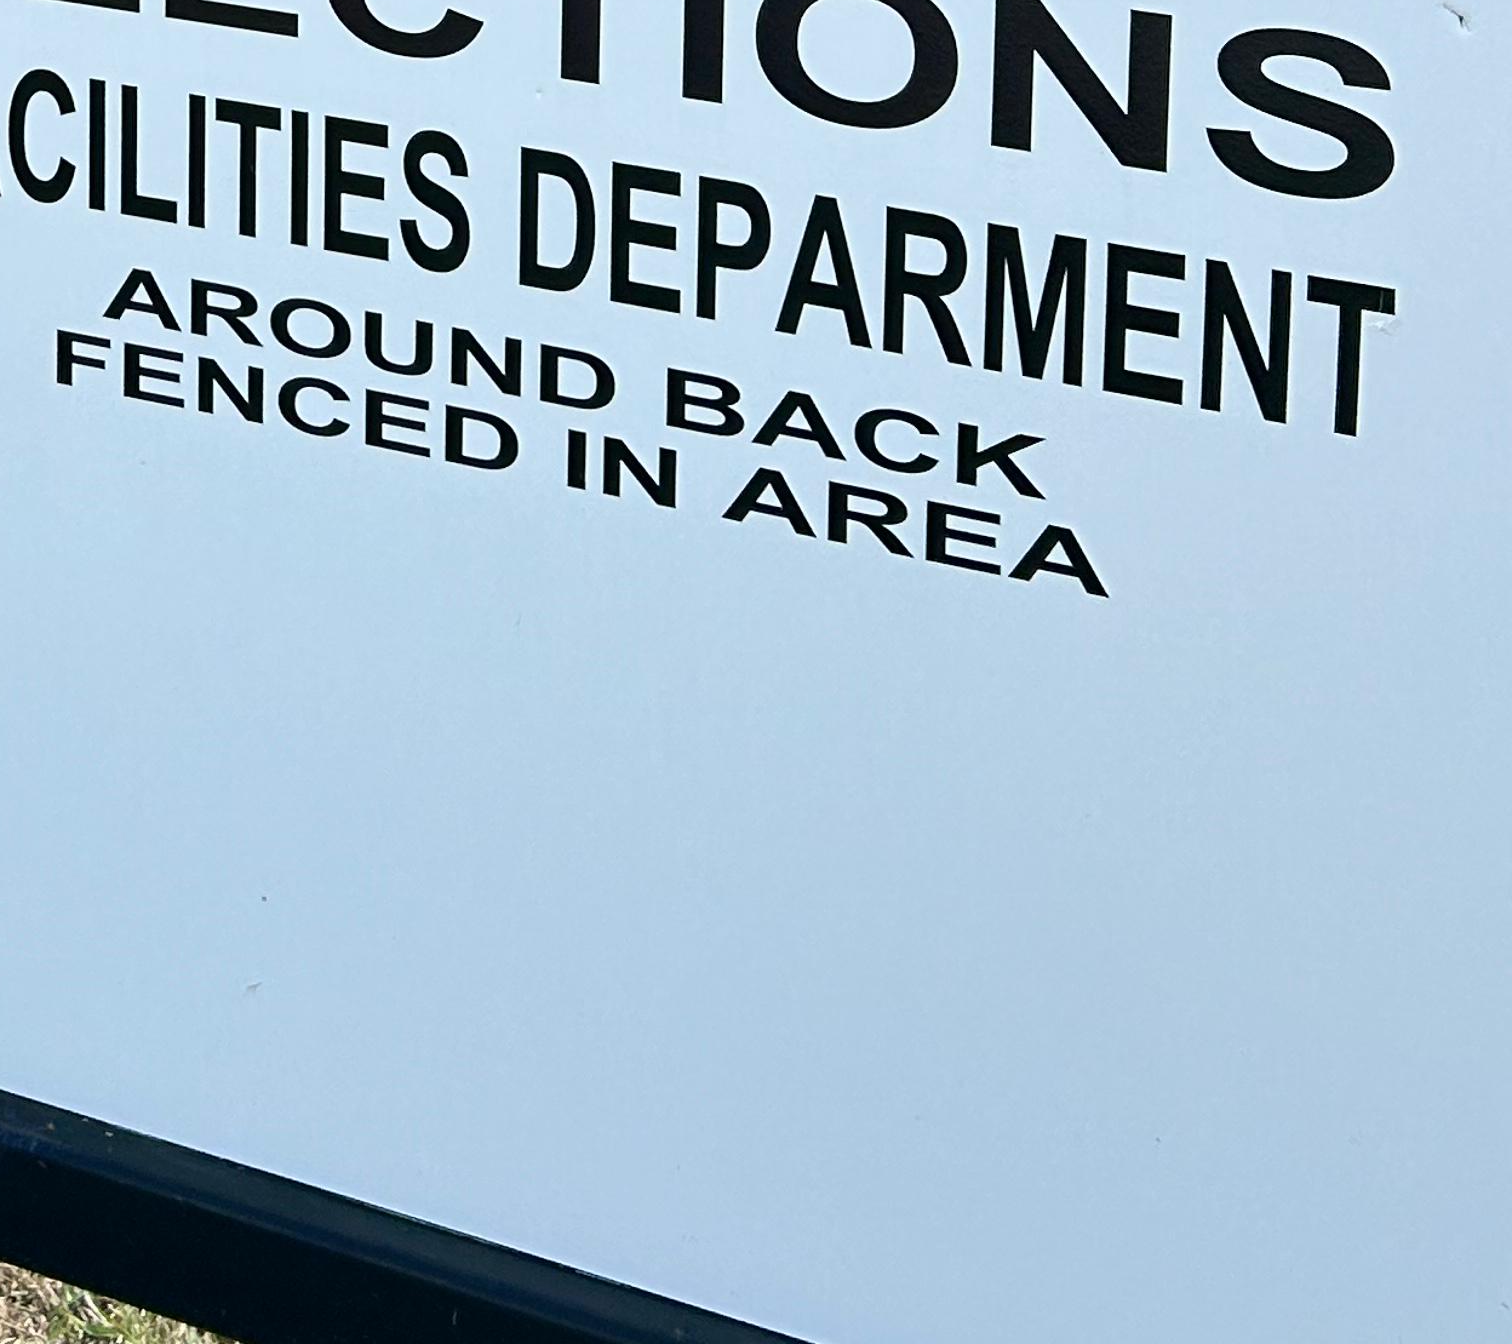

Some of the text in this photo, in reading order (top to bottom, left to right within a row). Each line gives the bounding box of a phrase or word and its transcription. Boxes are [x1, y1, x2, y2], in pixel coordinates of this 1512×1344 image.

[101, 267, 1047, 501] AROUND BACK
[518, 145, 1397, 438] DEPARMENT
[55, 328, 1111, 600] FENCED IN AREA
